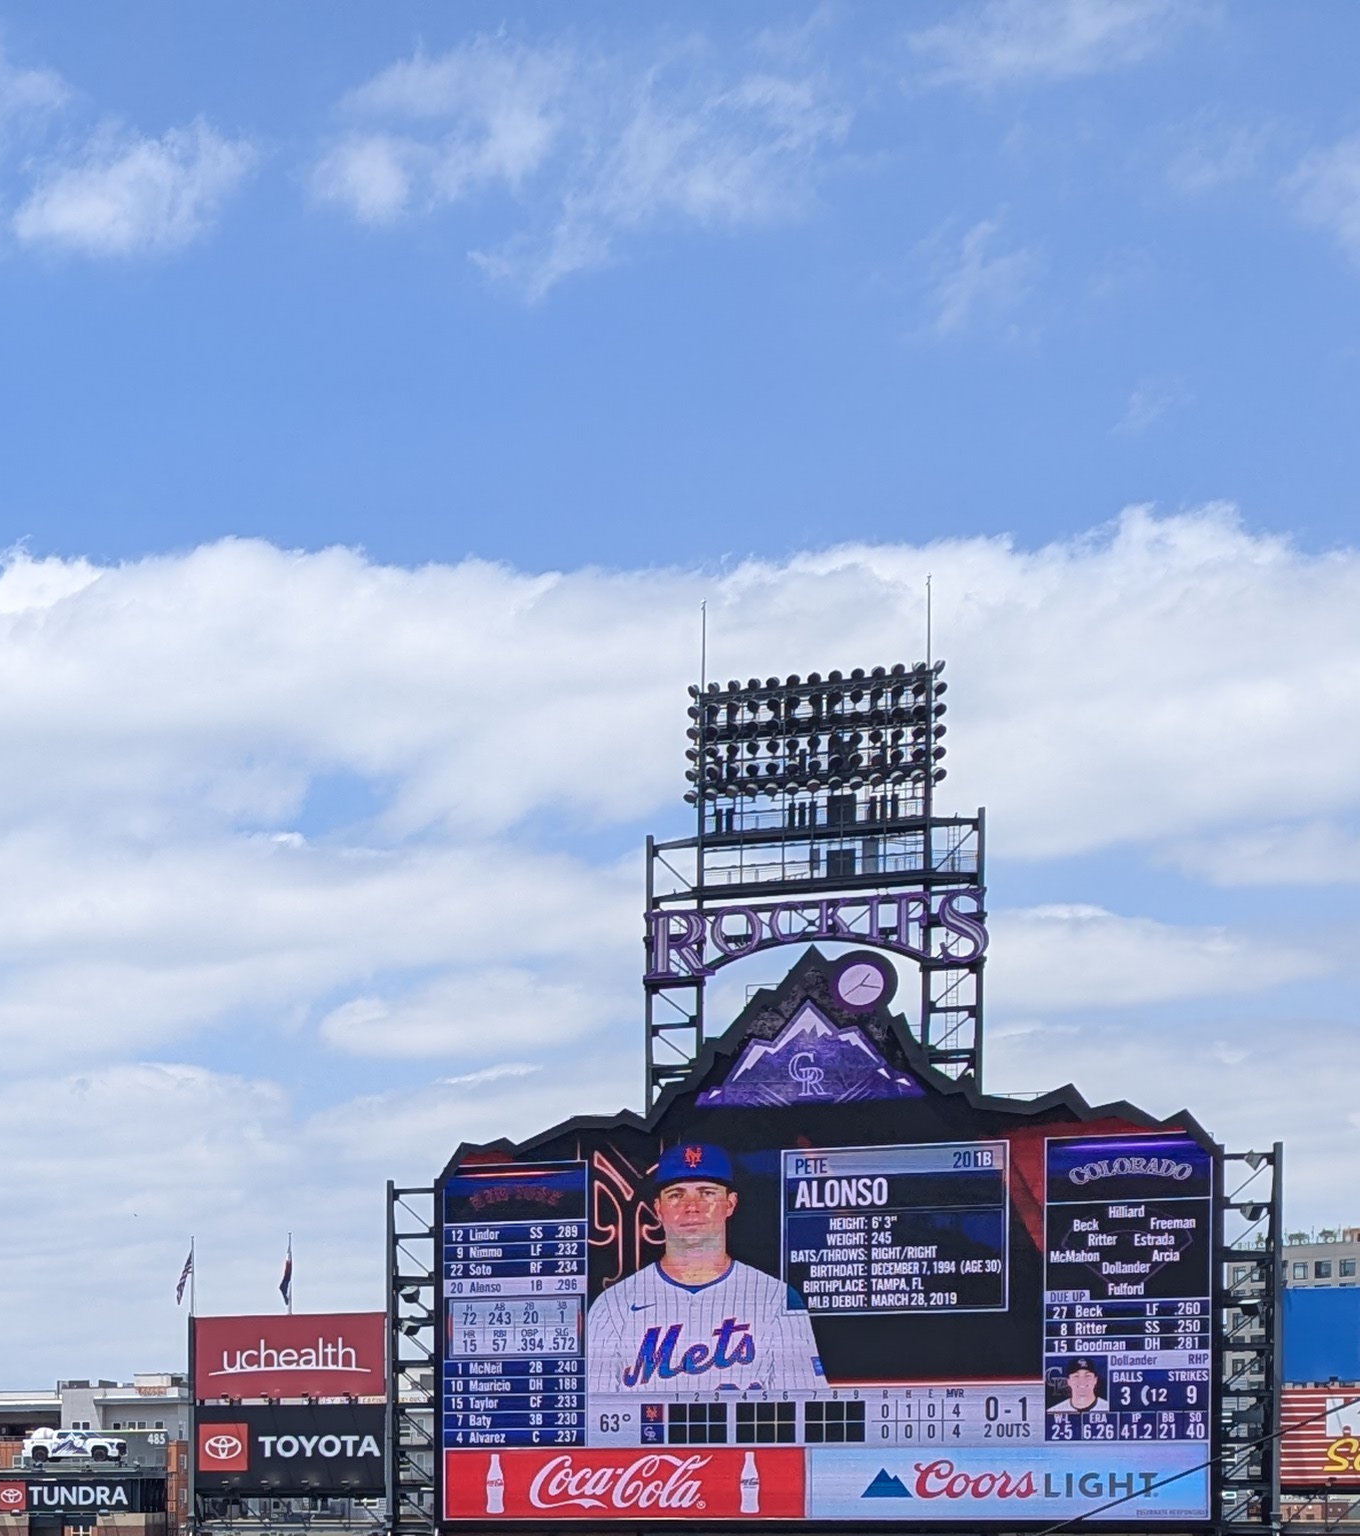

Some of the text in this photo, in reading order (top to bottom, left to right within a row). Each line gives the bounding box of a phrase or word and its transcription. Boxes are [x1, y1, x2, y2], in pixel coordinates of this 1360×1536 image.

[643, 887, 990, 980] ROCKIES
[795, 1151, 992, 1175] PETE 20 1B
[1068, 1158, 1193, 1185] COLORADO
[794, 1177, 889, 1209] ALONSO
[1108, 1205, 1145, 1219] Hilliard
[829, 1217, 868, 1231] HEIGHT:
[1073, 1217, 1196, 1232] Beck Freeman
[469, 1225, 578, 1240] Lindor .289
[826, 1232, 892, 1247] WEIGHT: 245
[1088, 1233, 1175, 1247] Ritter Estrada
[469, 1243, 578, 1258] Nimmo .232
[790, 1246, 938, 1263] BATS/THROWS: RIGHT/RIGHT
[1050, 1249, 1180, 1263] McMahon Arcia
[469, 1261, 578, 1276] Soto .234
[810, 1264, 868, 1278] BIRTHDATE:
[871, 1261, 919, 1276] DECEMBER
[933, 1261, 955, 1274] 1994
[960, 1260, 983, 1275] (AGE
[985, 1260, 1002, 1274] 30)
[1102, 1261, 1151, 1275] Dollander
[469, 1278, 578, 1294] Alonso .296
[803, 1277, 925, 1293] BIRTHPLACE: TAMPA, FL
[1108, 1282, 1145, 1296] Fulford
[808, 1292, 957, 1309] MLB DEBUT: MARCH 28, 2019
[1050, 1291, 1086, 1302] DUE UP
[1075, 1302, 1201, 1318] Beck .260
[488, 1312, 512, 1325] 243
[1074, 1320, 1201, 1335] Ritter .250
[517, 1337, 575, 1351] .394 .572
[1074, 1336, 1200, 1351] Goodman .281
[222, 1336, 356, 1372] uchealth
[623, 1317, 756, 1388] Mets
[1110, 1354, 1209, 1366] Dollander RHP
[469, 1360, 578, 1375] McNeil .240
[1112, 1370, 1209, 1383] BALLS STRIKES
[469, 1378, 578, 1392] Mauricio .188
[469, 1395, 578, 1412] Taylor .233
[469, 1413, 578, 1429] Baty .230
[469, 1430, 577, 1444] Alvarez .237
[984, 1423, 1031, 1438] 2 OUTS
[1083, 1424, 1152, 1440] 6.26 41.2
[147, 1433, 166, 1446] 485
[257, 1434, 381, 1458] TOYOTA
[529, 1454, 714, 1510] Coca-Cola
[913, 1459, 1158, 1499] Coors LIGHT
[28, 1485, 129, 1506] TUNDRA
